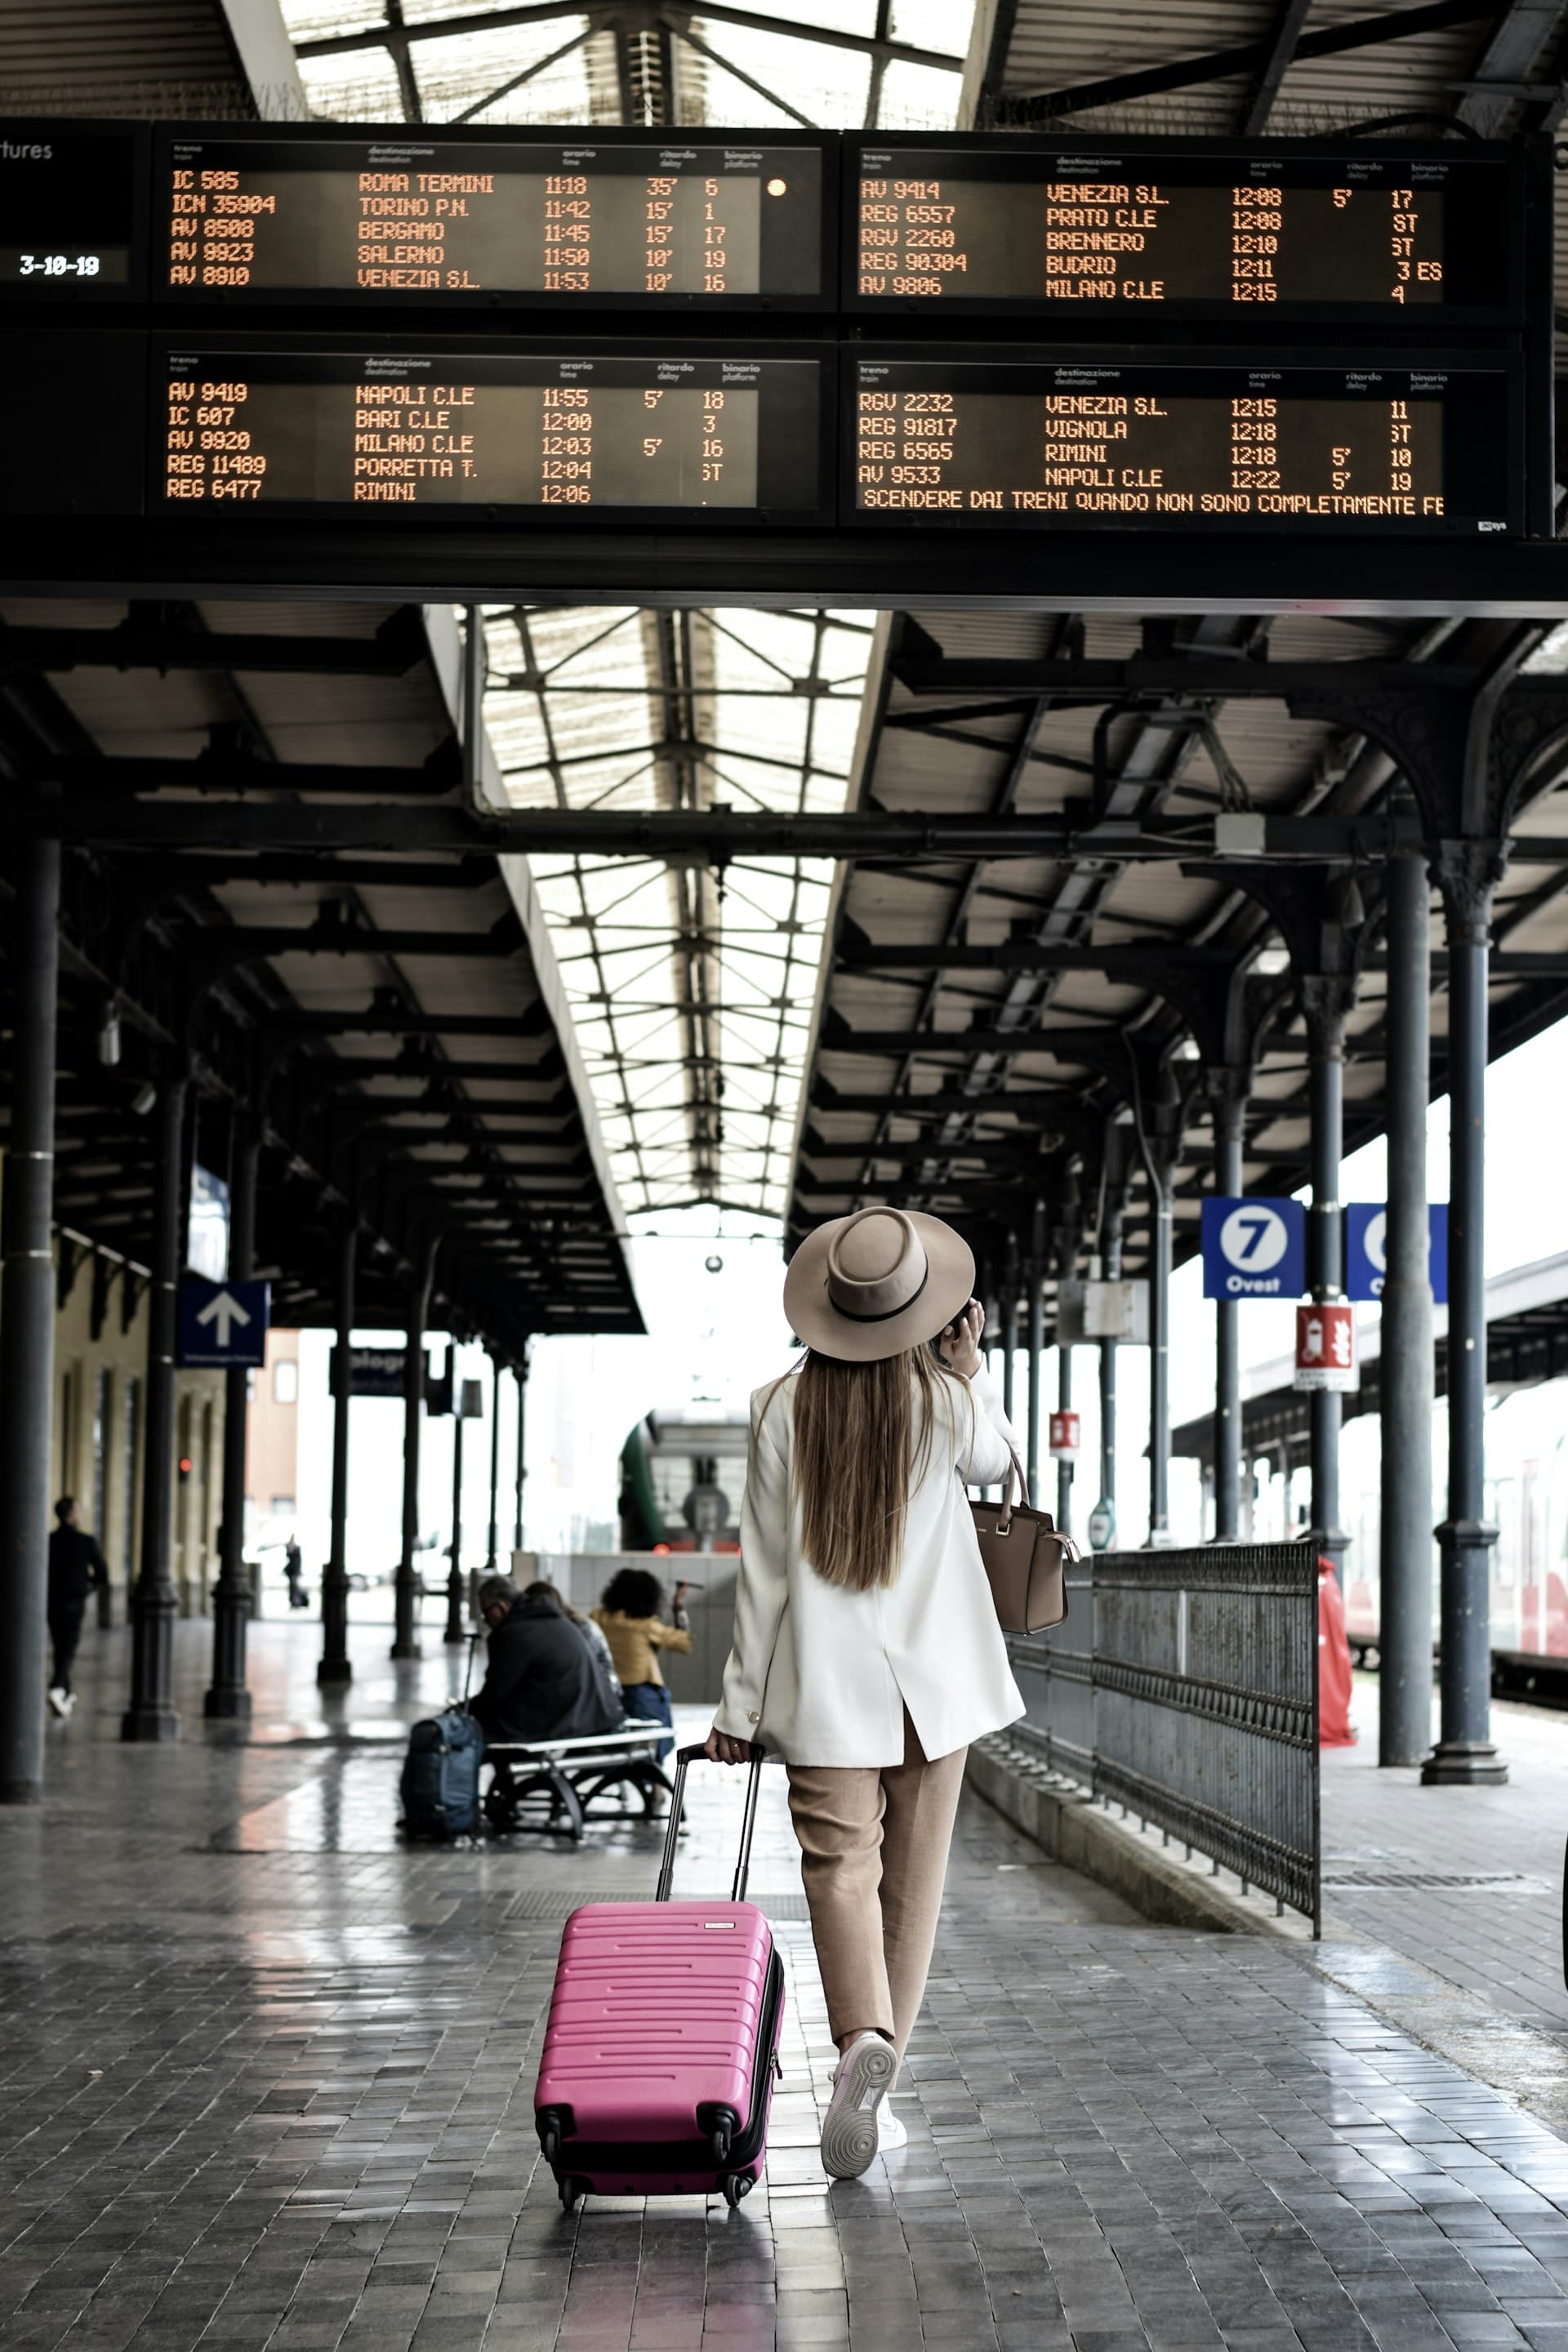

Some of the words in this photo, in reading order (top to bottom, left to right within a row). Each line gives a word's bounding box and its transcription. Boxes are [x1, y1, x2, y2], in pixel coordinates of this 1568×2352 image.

[0, 140, 53, 160] tures
[173, 170, 194, 189] IC
[201, 171, 239, 190] 585
[359, 173, 410, 193] ROMA
[416, 174, 495, 194] TERMINI
[704, 178, 719, 197] 6
[861, 180, 888, 199] AV
[893, 180, 940, 200] 9414
[1047, 184, 1129, 203] VENEZIA
[1232, 187, 1282, 207] 12:08
[1391, 189, 1413, 209] 17
[172, 194, 207, 213] ICN
[359, 197, 430, 216] TORINO
[544, 199, 591, 219] 11:42
[704, 203, 715, 221] 1
[861, 203, 899, 223] REG
[905, 205, 956, 224] 6557
[1046, 207, 1109, 227] PRATO
[1232, 211, 1282, 230] 12:08
[1393, 214, 1419, 233] ST
[172, 218, 198, 237] AV
[203, 218, 255, 238] 8508
[358, 220, 445, 241] BERGAMO
[543, 223, 591, 243] 11:45
[704, 225, 727, 245] 17
[860, 228, 899, 247] RGV
[904, 229, 956, 248] 2260
[1046, 231, 1145, 252] BRENNERO
[1232, 234, 1278, 254] 12:10
[171, 242, 197, 261] AV
[357, 244, 445, 265] SALERNO
[543, 247, 590, 266] 11:50
[703, 249, 727, 269] 19
[860, 252, 898, 270] REG
[904, 252, 967, 272] 90304
[1045, 255, 1116, 274] BUDRIO
[1232, 258, 1273, 278] 12:11
[1397, 261, 1410, 280] 3
[1417, 261, 1442, 281] ES
[170, 265, 197, 285] AV
[357, 268, 440, 288] VENEZIA
[543, 271, 590, 291] 11:53
[703, 273, 726, 292] 16
[860, 275, 886, 294] AV
[892, 276, 942, 296] 9806
[1045, 279, 1116, 298] MILANO
[1232, 283, 1277, 301] 12:15
[1391, 285, 1405, 304] 4
[657, 363, 694, 372] ritardo
[722, 363, 760, 372] binario
[860, 367, 889, 375] treno
[168, 382, 195, 401] AV
[201, 382, 247, 402] 9419
[355, 385, 427, 405] NAPOLI
[542, 388, 589, 408] 11:55
[702, 390, 726, 410] 18
[858, 393, 898, 412] RGV
[903, 394, 954, 412] 2232
[1045, 395, 1128, 415] VENEZIA
[1232, 399, 1276, 417] 12:15
[1391, 400, 1408, 420] 11
[168, 406, 190, 425] IC
[196, 407, 235, 425] 607
[355, 409, 402, 429] BARI
[541, 412, 593, 432] 12:00
[702, 415, 717, 434] 3
[858, 416, 897, 436] REG
[903, 417, 958, 436] 91817
[1045, 420, 1128, 439] VIGNOLA
[1232, 422, 1276, 441] 12:18
[167, 430, 194, 449] AV
[200, 430, 251, 451] 9920
[354, 434, 425, 453] MILANO
[541, 436, 592, 456] 12:03
[702, 439, 724, 458] 16
[858, 440, 896, 460] REG
[902, 442, 953, 461] 6565
[1045, 443, 1107, 463] RIMINI
[1232, 446, 1276, 465] 12:18
[1390, 448, 1412, 467] 10
[167, 454, 205, 474] REG
[212, 455, 266, 474] 11489
[354, 457, 453, 478] PORRETTA
[541, 460, 592, 479] 12:04
[858, 465, 884, 483] AV
[890, 466, 941, 484] 9533
[1045, 468, 1115, 487] NAPOLI
[1231, 470, 1281, 489] 12:22
[1391, 472, 1412, 491] 19
[167, 479, 205, 498] REG
[212, 479, 262, 499] 6477
[354, 481, 416, 501] RIMINI
[541, 484, 591, 504] 12:06
[864, 489, 963, 509] SCENDERE
[969, 490, 1004, 509] DAI
[1011, 491, 1068, 510] TRENI
[1076, 492, 1149, 511] QUANDO
[1156, 492, 1193, 512] NON
[1200, 493, 1250, 512] SONO
[1258, 494, 1416, 515] COMPLETAMENTE
[1239, 1219, 1272, 1259] 7
[1227, 1276, 1281, 1293] Ovest
